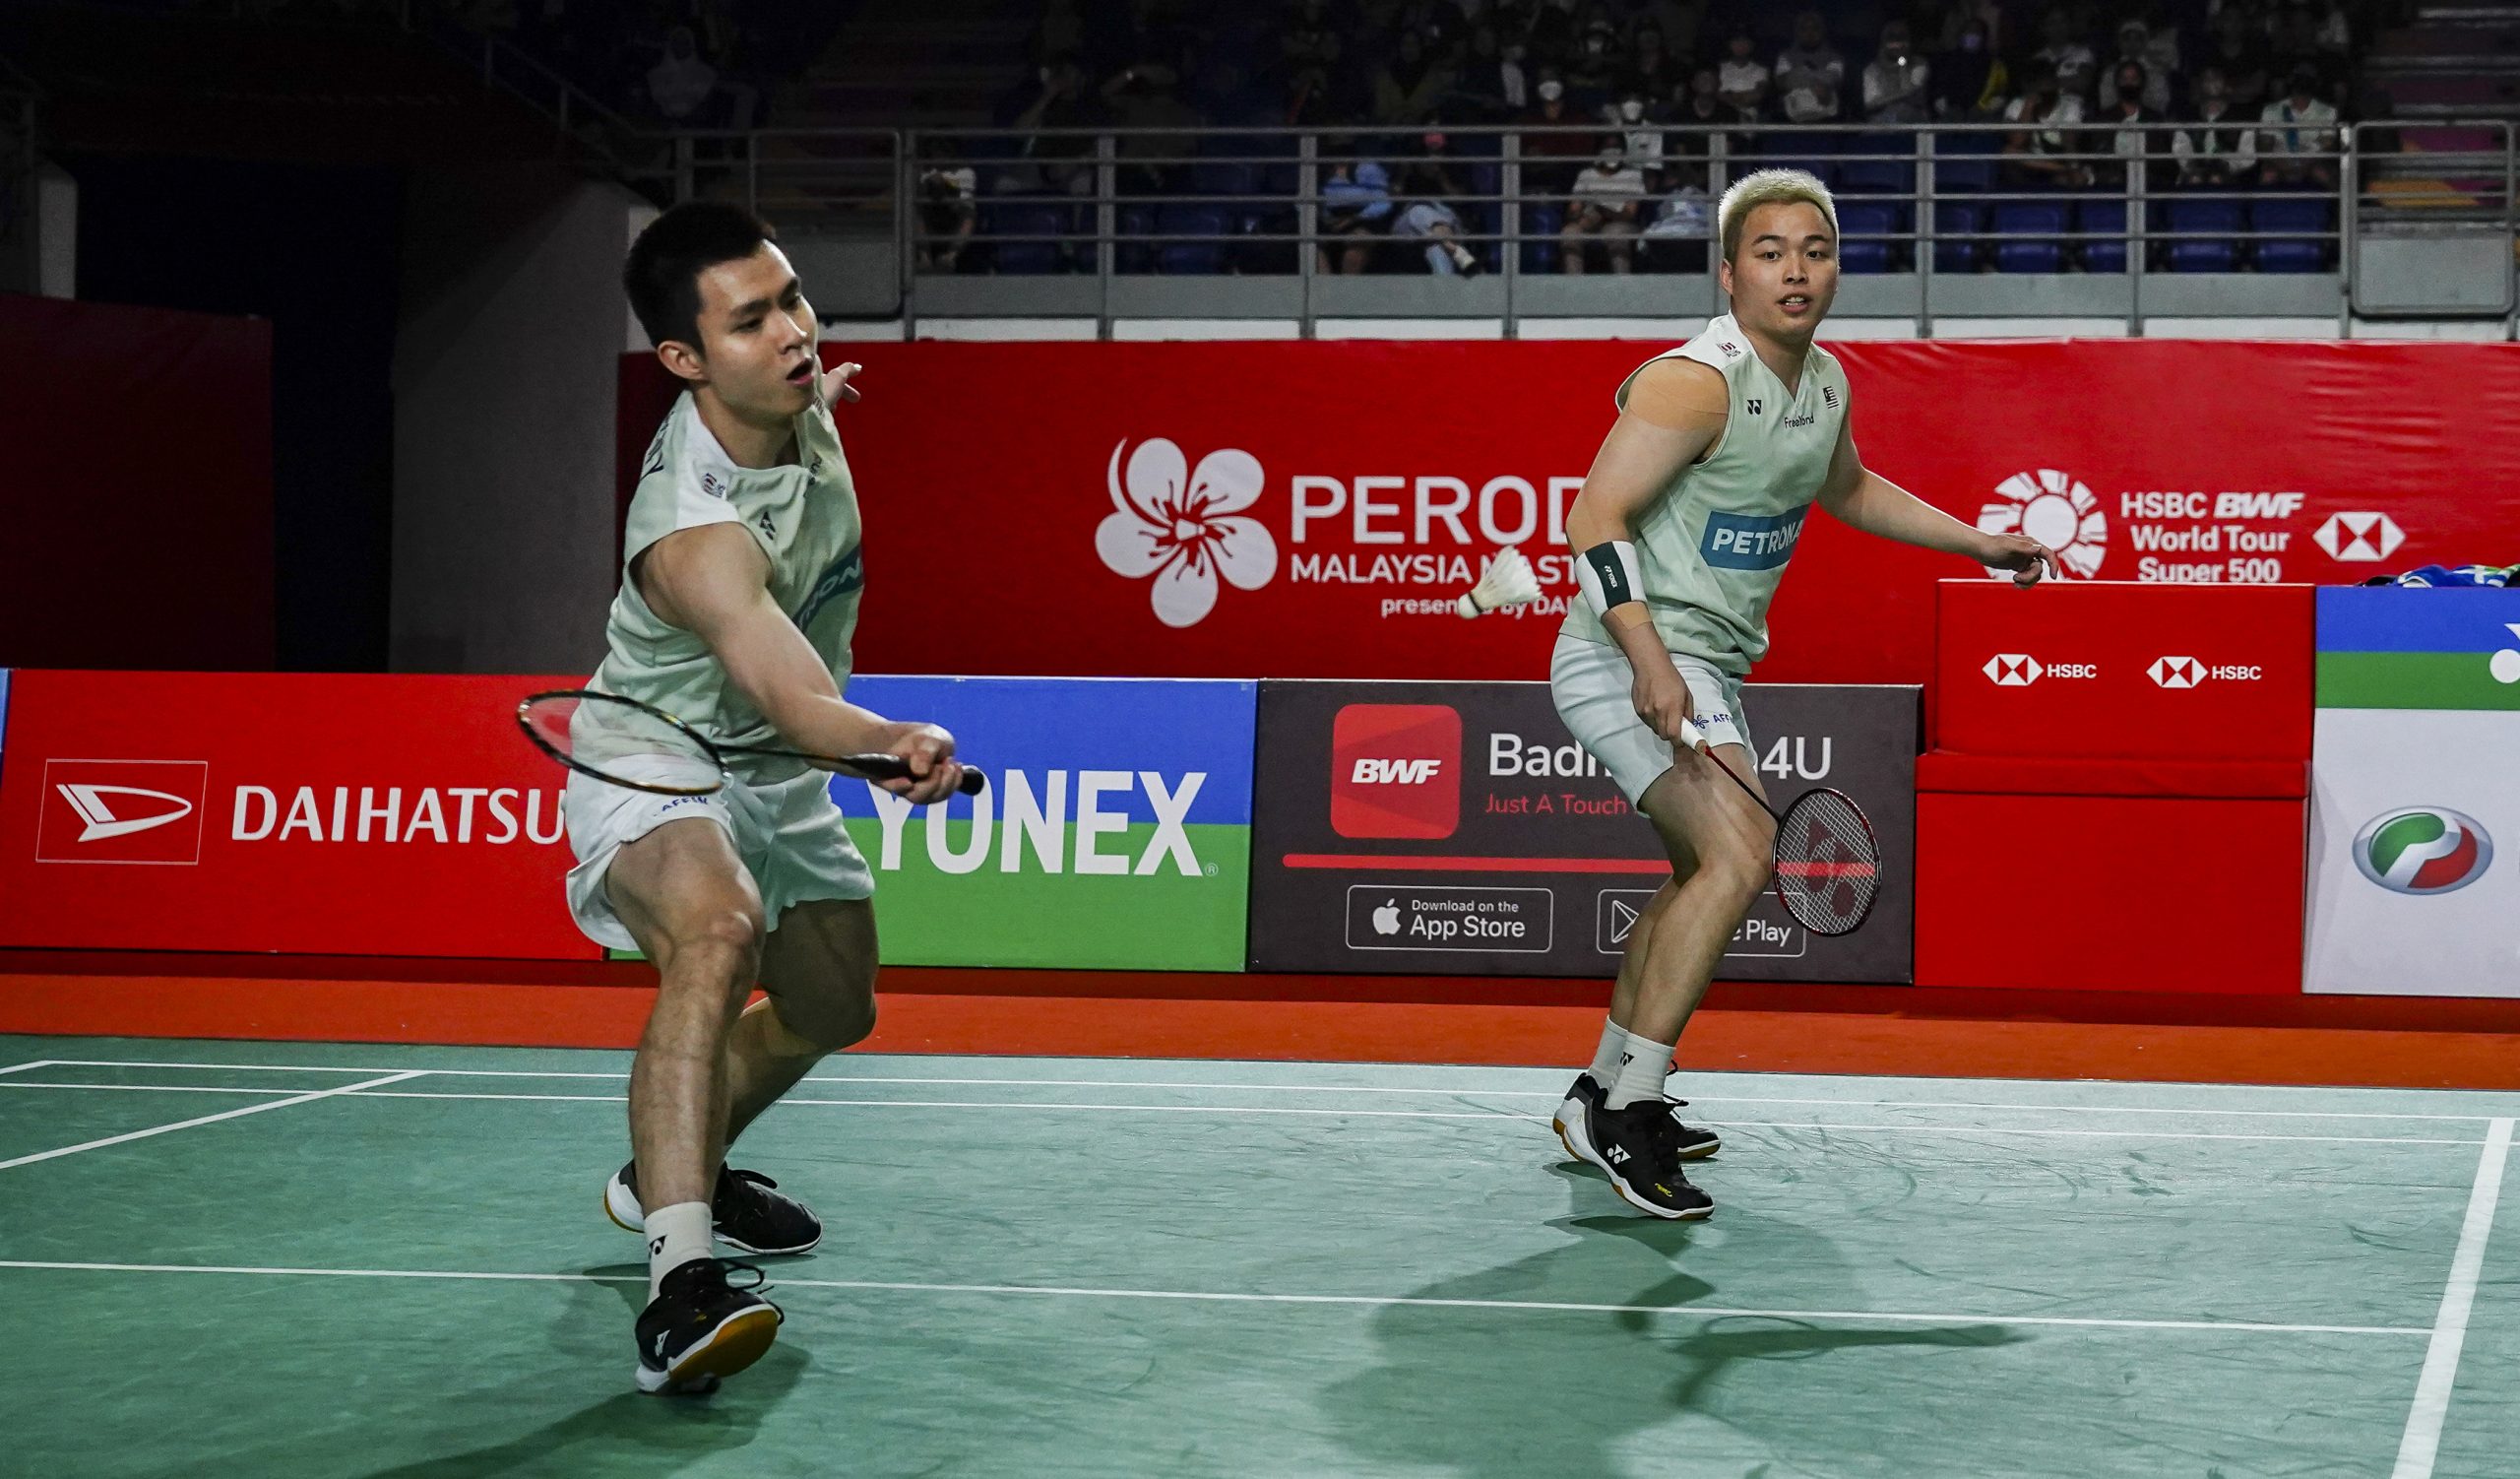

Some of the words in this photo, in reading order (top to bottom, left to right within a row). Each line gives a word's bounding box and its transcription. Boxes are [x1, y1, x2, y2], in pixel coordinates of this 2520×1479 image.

[1292, 476, 1588, 547] PEROD
[2120, 492, 2208, 518] HSBC
[2213, 492, 2305, 519] BWF
[1711, 519, 1805, 555] PETRONA
[2130, 525, 2220, 552] World
[2223, 525, 2291, 552] Tour
[1292, 553, 1474, 584] MALAYSIA
[2137, 557, 2225, 582] Super
[2228, 557, 2282, 583] 500
[2047, 663, 2098, 679] HSBC
[2211, 665, 2262, 681] HSBC
[1352, 758, 1442, 785] BWF
[231, 785, 566, 845] DAIHATSU
[1485, 793, 1529, 814] Just
[1536, 794, 1553, 814] A
[1560, 794, 1627, 816] Touch
[869, 769, 1207, 876] YONEX
[1412, 899, 1474, 913] Download
[1478, 903, 1493, 913] on
[1497, 900, 1519, 913] the
[1410, 916, 1458, 942] App
[1463, 916, 1526, 938] Store
[1746, 920, 1792, 947] Play
